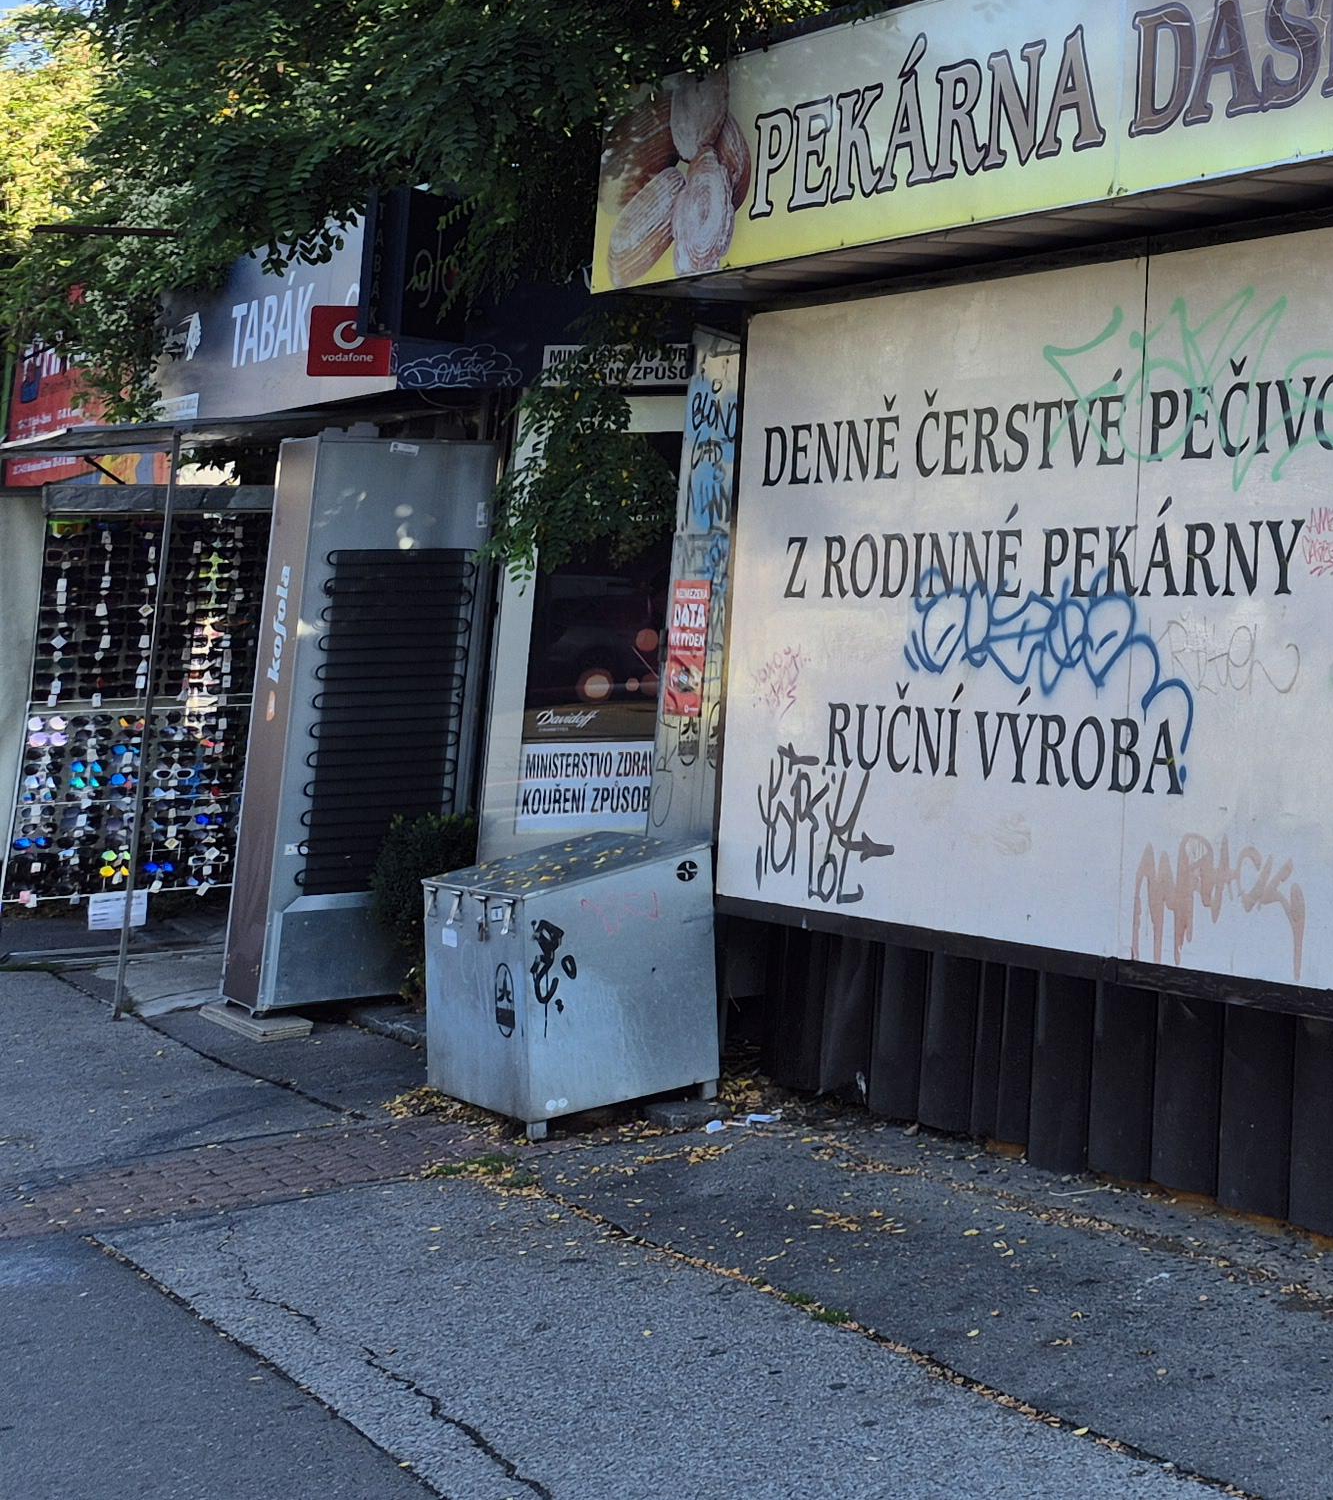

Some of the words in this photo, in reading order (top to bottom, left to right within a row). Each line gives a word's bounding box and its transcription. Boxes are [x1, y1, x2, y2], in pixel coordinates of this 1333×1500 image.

[748, 32, 1105, 220] PEKÁRNA
[232, 272, 315, 368] TABÁK
[321, 352, 374, 363] vodafone
[761, 395, 901, 488] DENNĚ
[915, 369, 1127, 479] ČERSTVÉ
[784, 535, 809, 599] Z
[821, 503, 1024, 600] RODINNÉ
[1040, 496, 1305, 598] PEKÁRNY
[267, 565, 291, 684] kofola
[673, 603, 706, 628] DATA
[525, 752, 612, 779] MINISTERSTVO
[536, 708, 599, 728] Davidoff
[825, 682, 964, 777] RUČNÍ
[976, 687, 1185, 796] VÝROBA
[521, 783, 588, 815] KOUŘENÍ
[591, 780, 650, 813] ZPŮSOB
